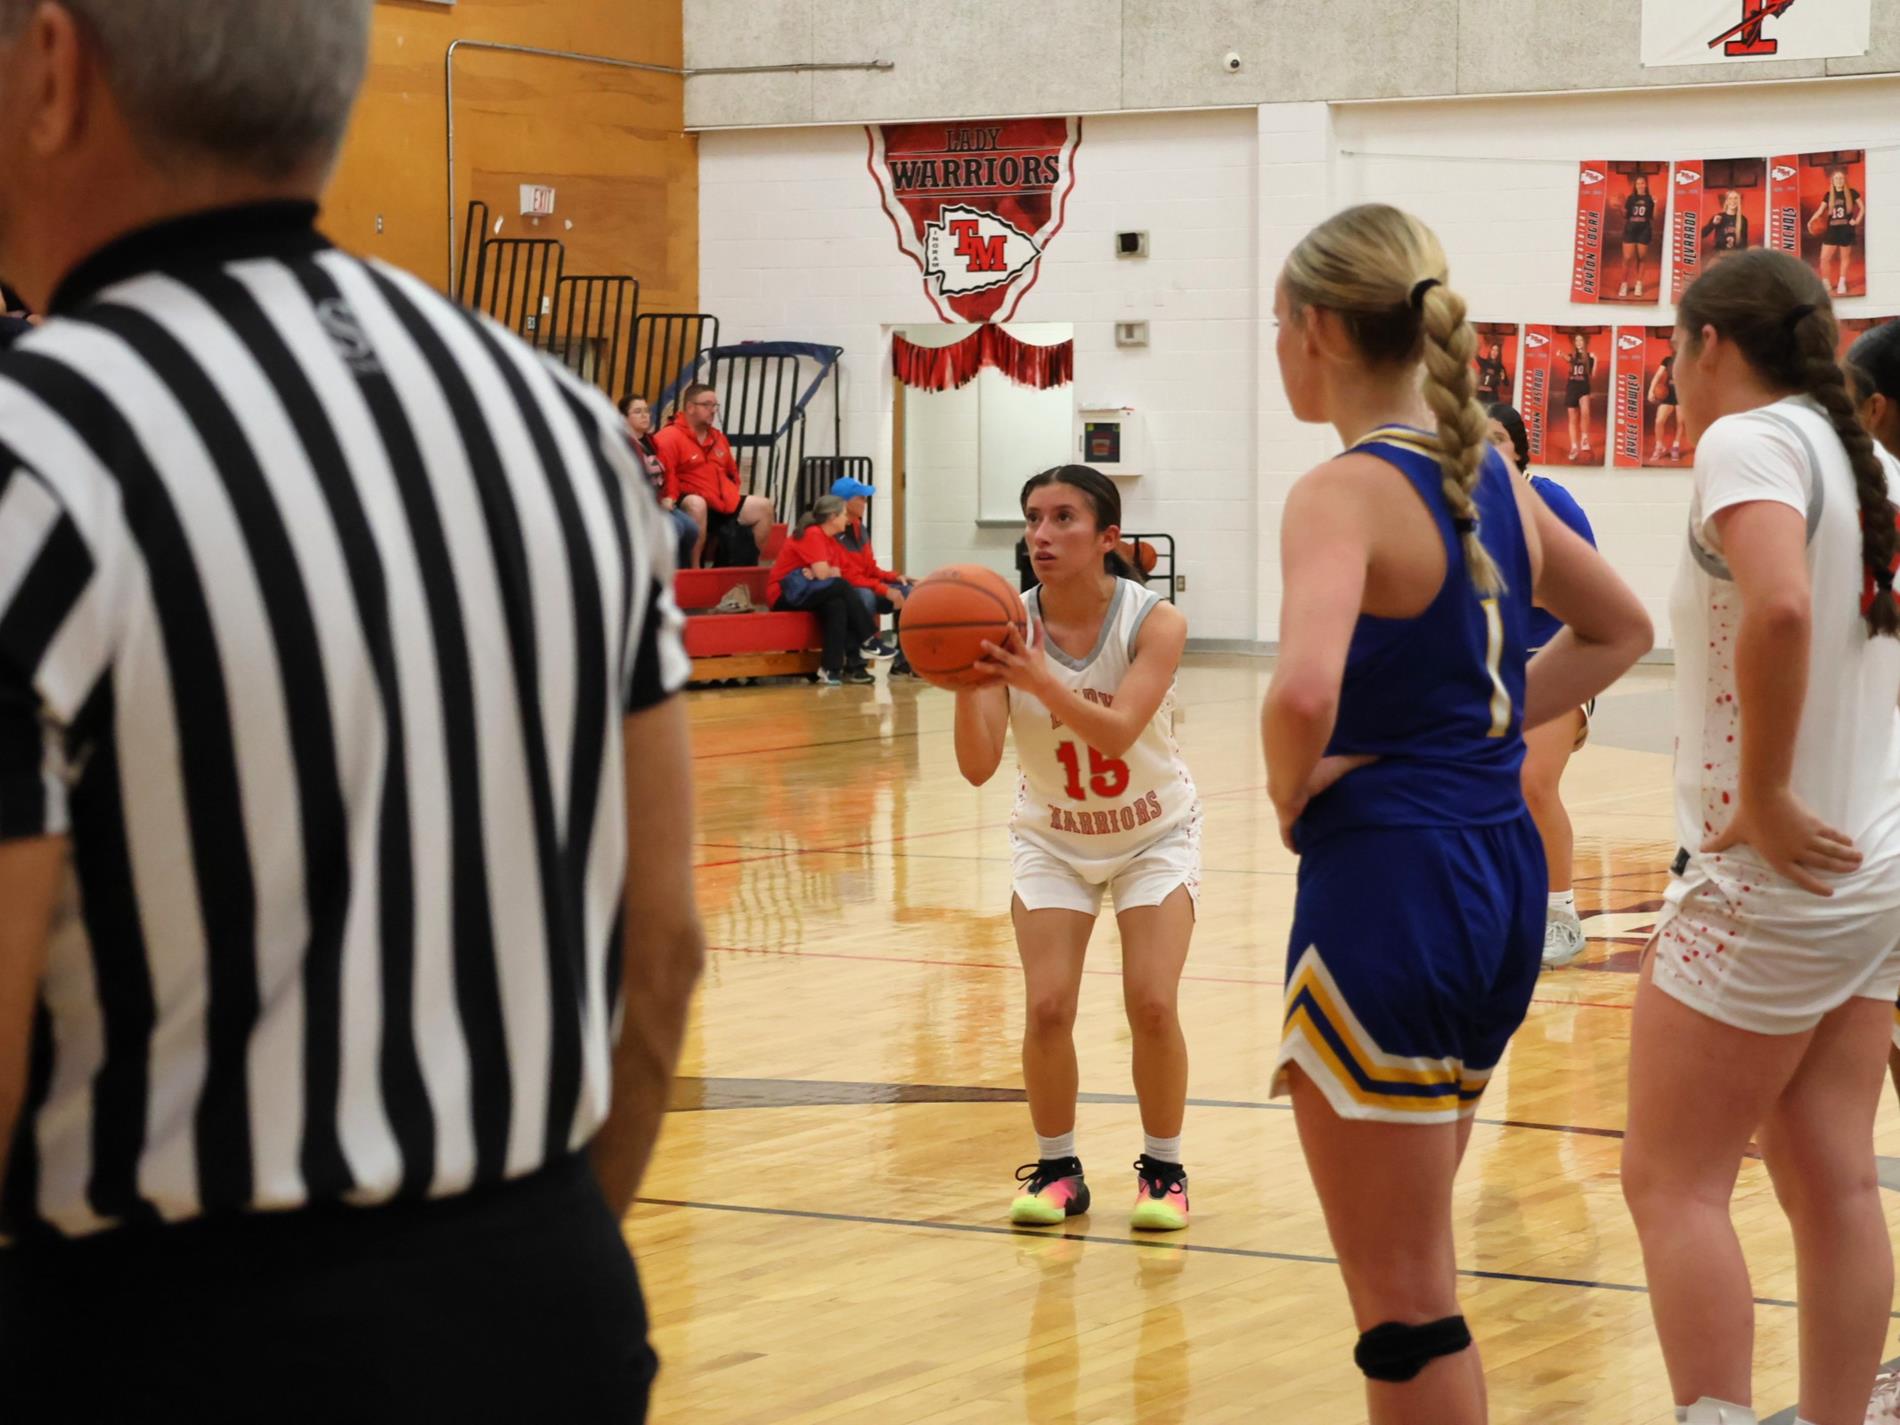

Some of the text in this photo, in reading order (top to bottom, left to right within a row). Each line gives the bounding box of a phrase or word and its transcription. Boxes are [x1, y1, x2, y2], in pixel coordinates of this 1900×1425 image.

[944, 127, 1001, 152] LADY
[889, 155, 1060, 191] WARRIORS
[532, 187, 552, 213] EXIT
[1832, 207, 1845, 219] 13
[949, 218, 1008, 273] TM
[1586, 211, 1599, 247] EDGAR
[1682, 212, 1697, 265] ALVARADO
[1782, 207, 1797, 251] NICHOLS
[1583, 252, 1597, 294] PAYTON
[1573, 364, 1585, 376] 10
[1627, 374, 1641, 419] CRAWLEY
[1479, 597, 1512, 738] 1
[1056, 740, 1130, 801] 15
